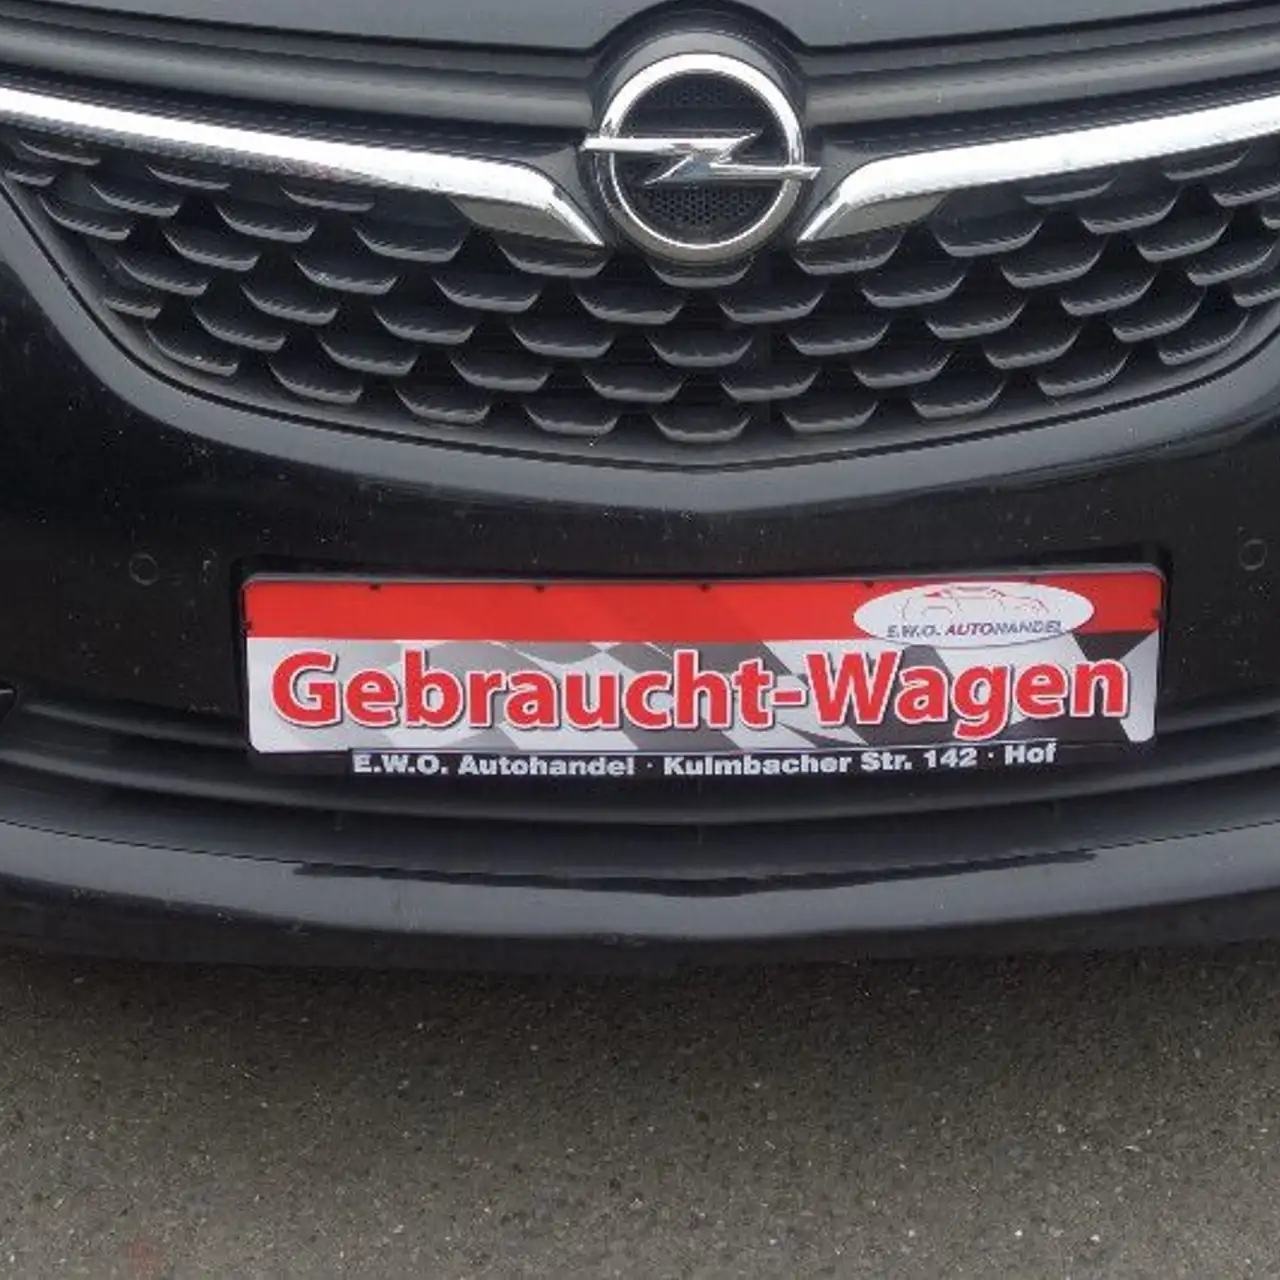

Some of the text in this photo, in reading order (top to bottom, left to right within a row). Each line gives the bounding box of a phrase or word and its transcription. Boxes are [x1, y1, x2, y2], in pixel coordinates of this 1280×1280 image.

[886, 620, 1062, 639] E.W.O. AUTOHANDEL
[271, 650, 1128, 738] Gebraucht-Wagen
[352, 742, 1057, 775] E.W.O. Autohandel Kulmbacher Str. 142 Hof
